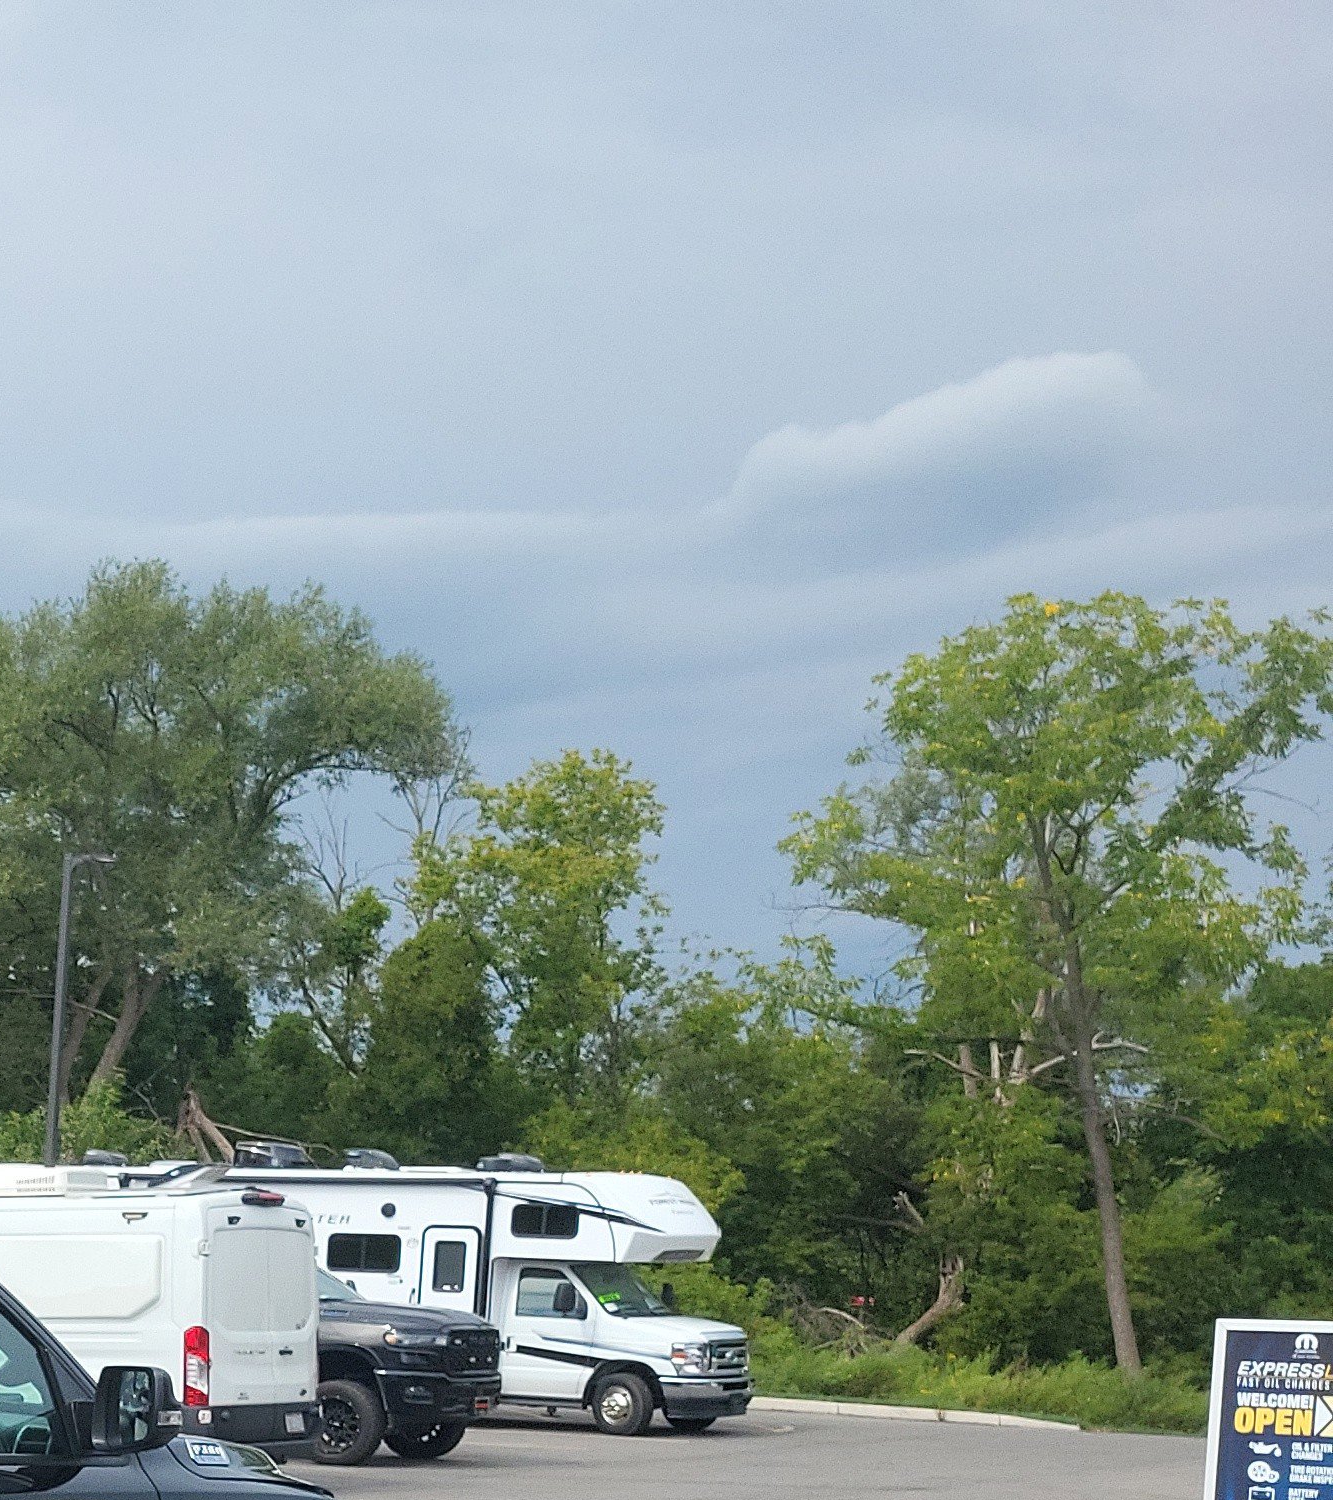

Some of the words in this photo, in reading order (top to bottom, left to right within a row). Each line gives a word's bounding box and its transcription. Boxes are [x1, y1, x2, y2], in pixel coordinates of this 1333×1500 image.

[1236, 1376, 1259, 1389] FAST
[1264, 1378, 1280, 1389] OIL
[1237, 1391, 1314, 1410] WELCOME!
[1234, 1406, 1313, 1436] OPEN
